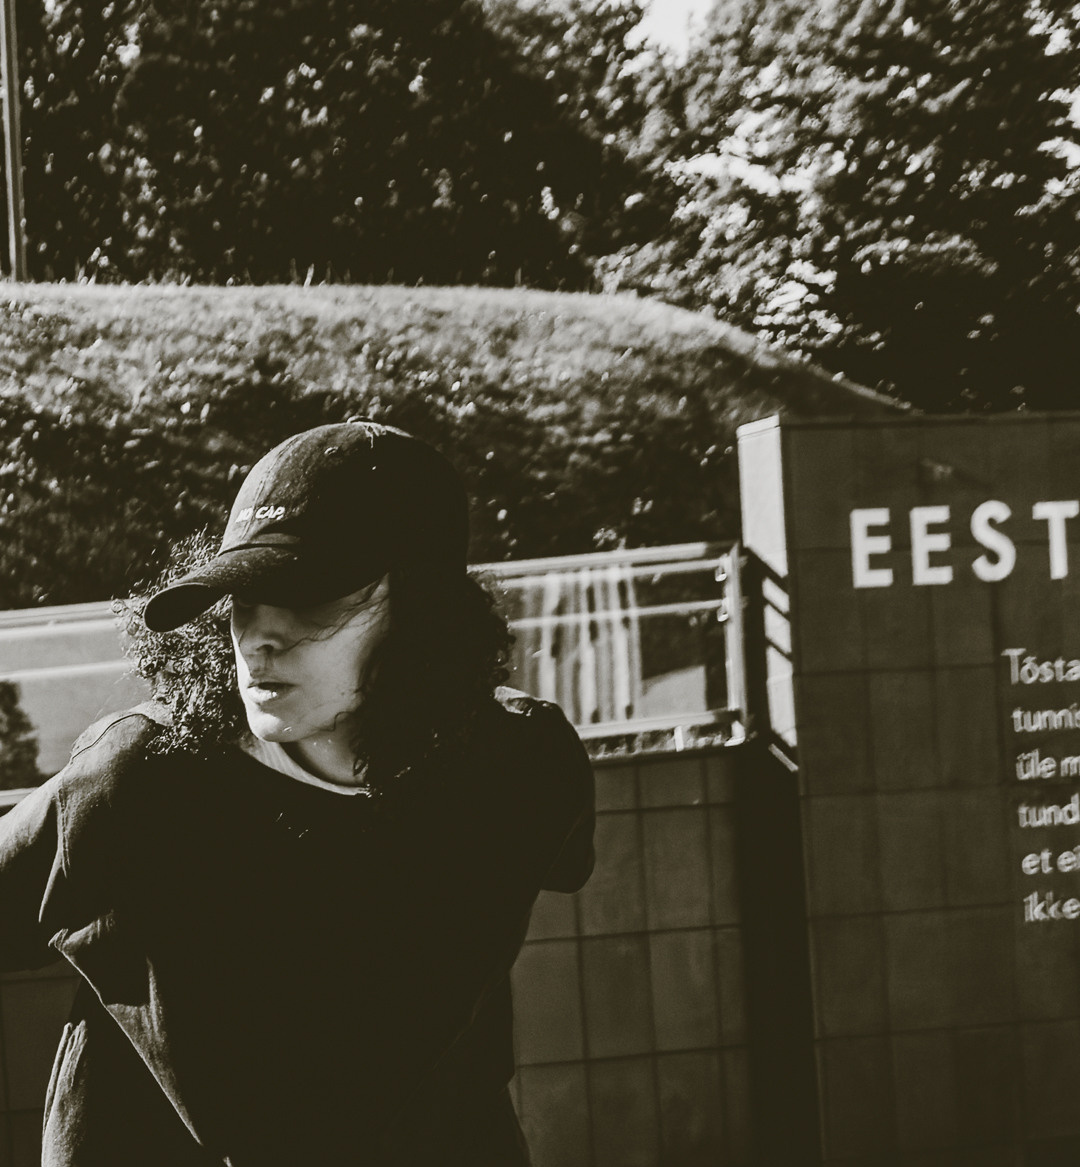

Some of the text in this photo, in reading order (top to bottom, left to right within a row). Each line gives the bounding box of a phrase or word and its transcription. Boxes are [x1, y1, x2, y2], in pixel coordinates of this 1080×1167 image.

[849, 500, 1080, 589] EEST
[1015, 748, 1057, 780] üle
[1018, 792, 1080, 828] tund
[1021, 848, 1053, 875] et
